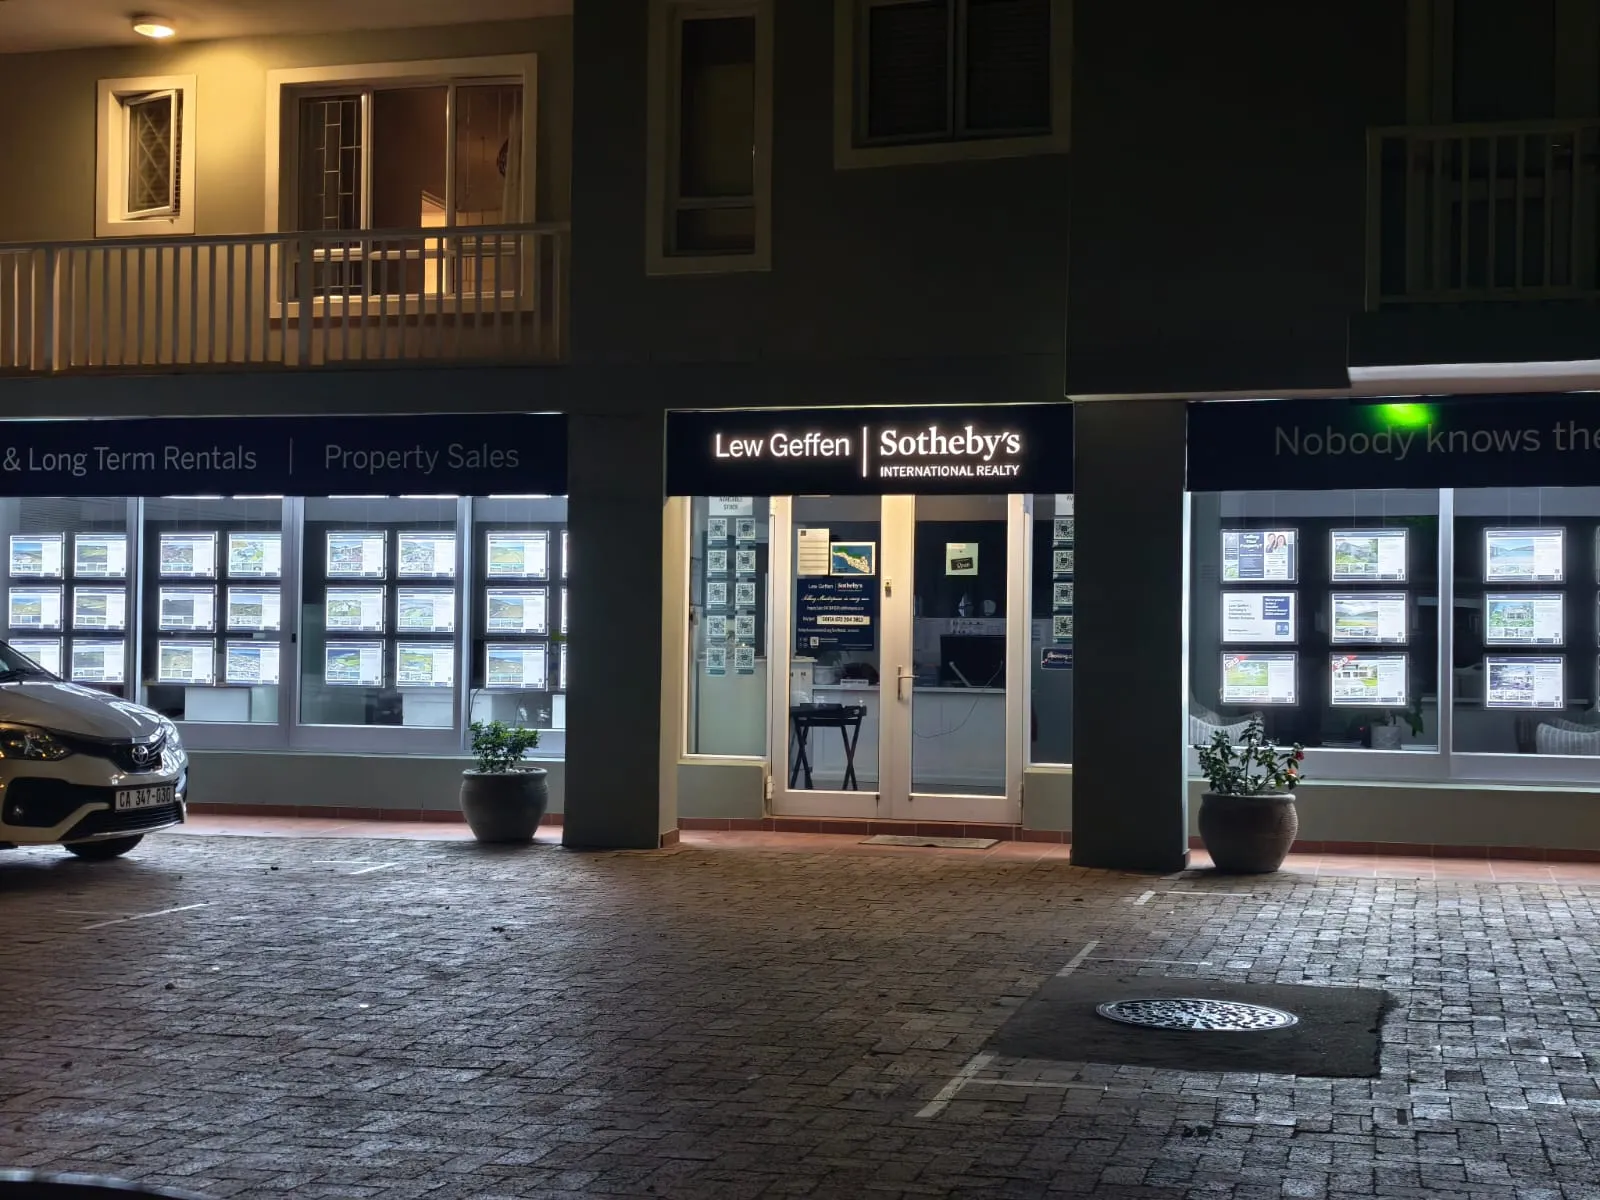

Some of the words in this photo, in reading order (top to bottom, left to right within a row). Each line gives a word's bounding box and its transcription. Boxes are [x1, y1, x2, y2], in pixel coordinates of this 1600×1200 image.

[715, 433, 763, 458] Lew
[769, 432, 850, 458] Geffen
[879, 425, 1021, 461] Sotheby's
[1275, 425, 1415, 461] Nobody
[1427, 423, 1541, 453] knows
[2, 447, 22, 472] &
[28, 447, 88, 477] Long
[93, 446, 155, 471] Term
[164, 445, 257, 471] Rentals
[325, 444, 439, 475] Property
[447, 443, 520, 469] Sales
[880, 465, 974, 478] INTERNATIONAL
[976, 464, 1020, 477] REALTY
[119, 791, 131, 808] CA
